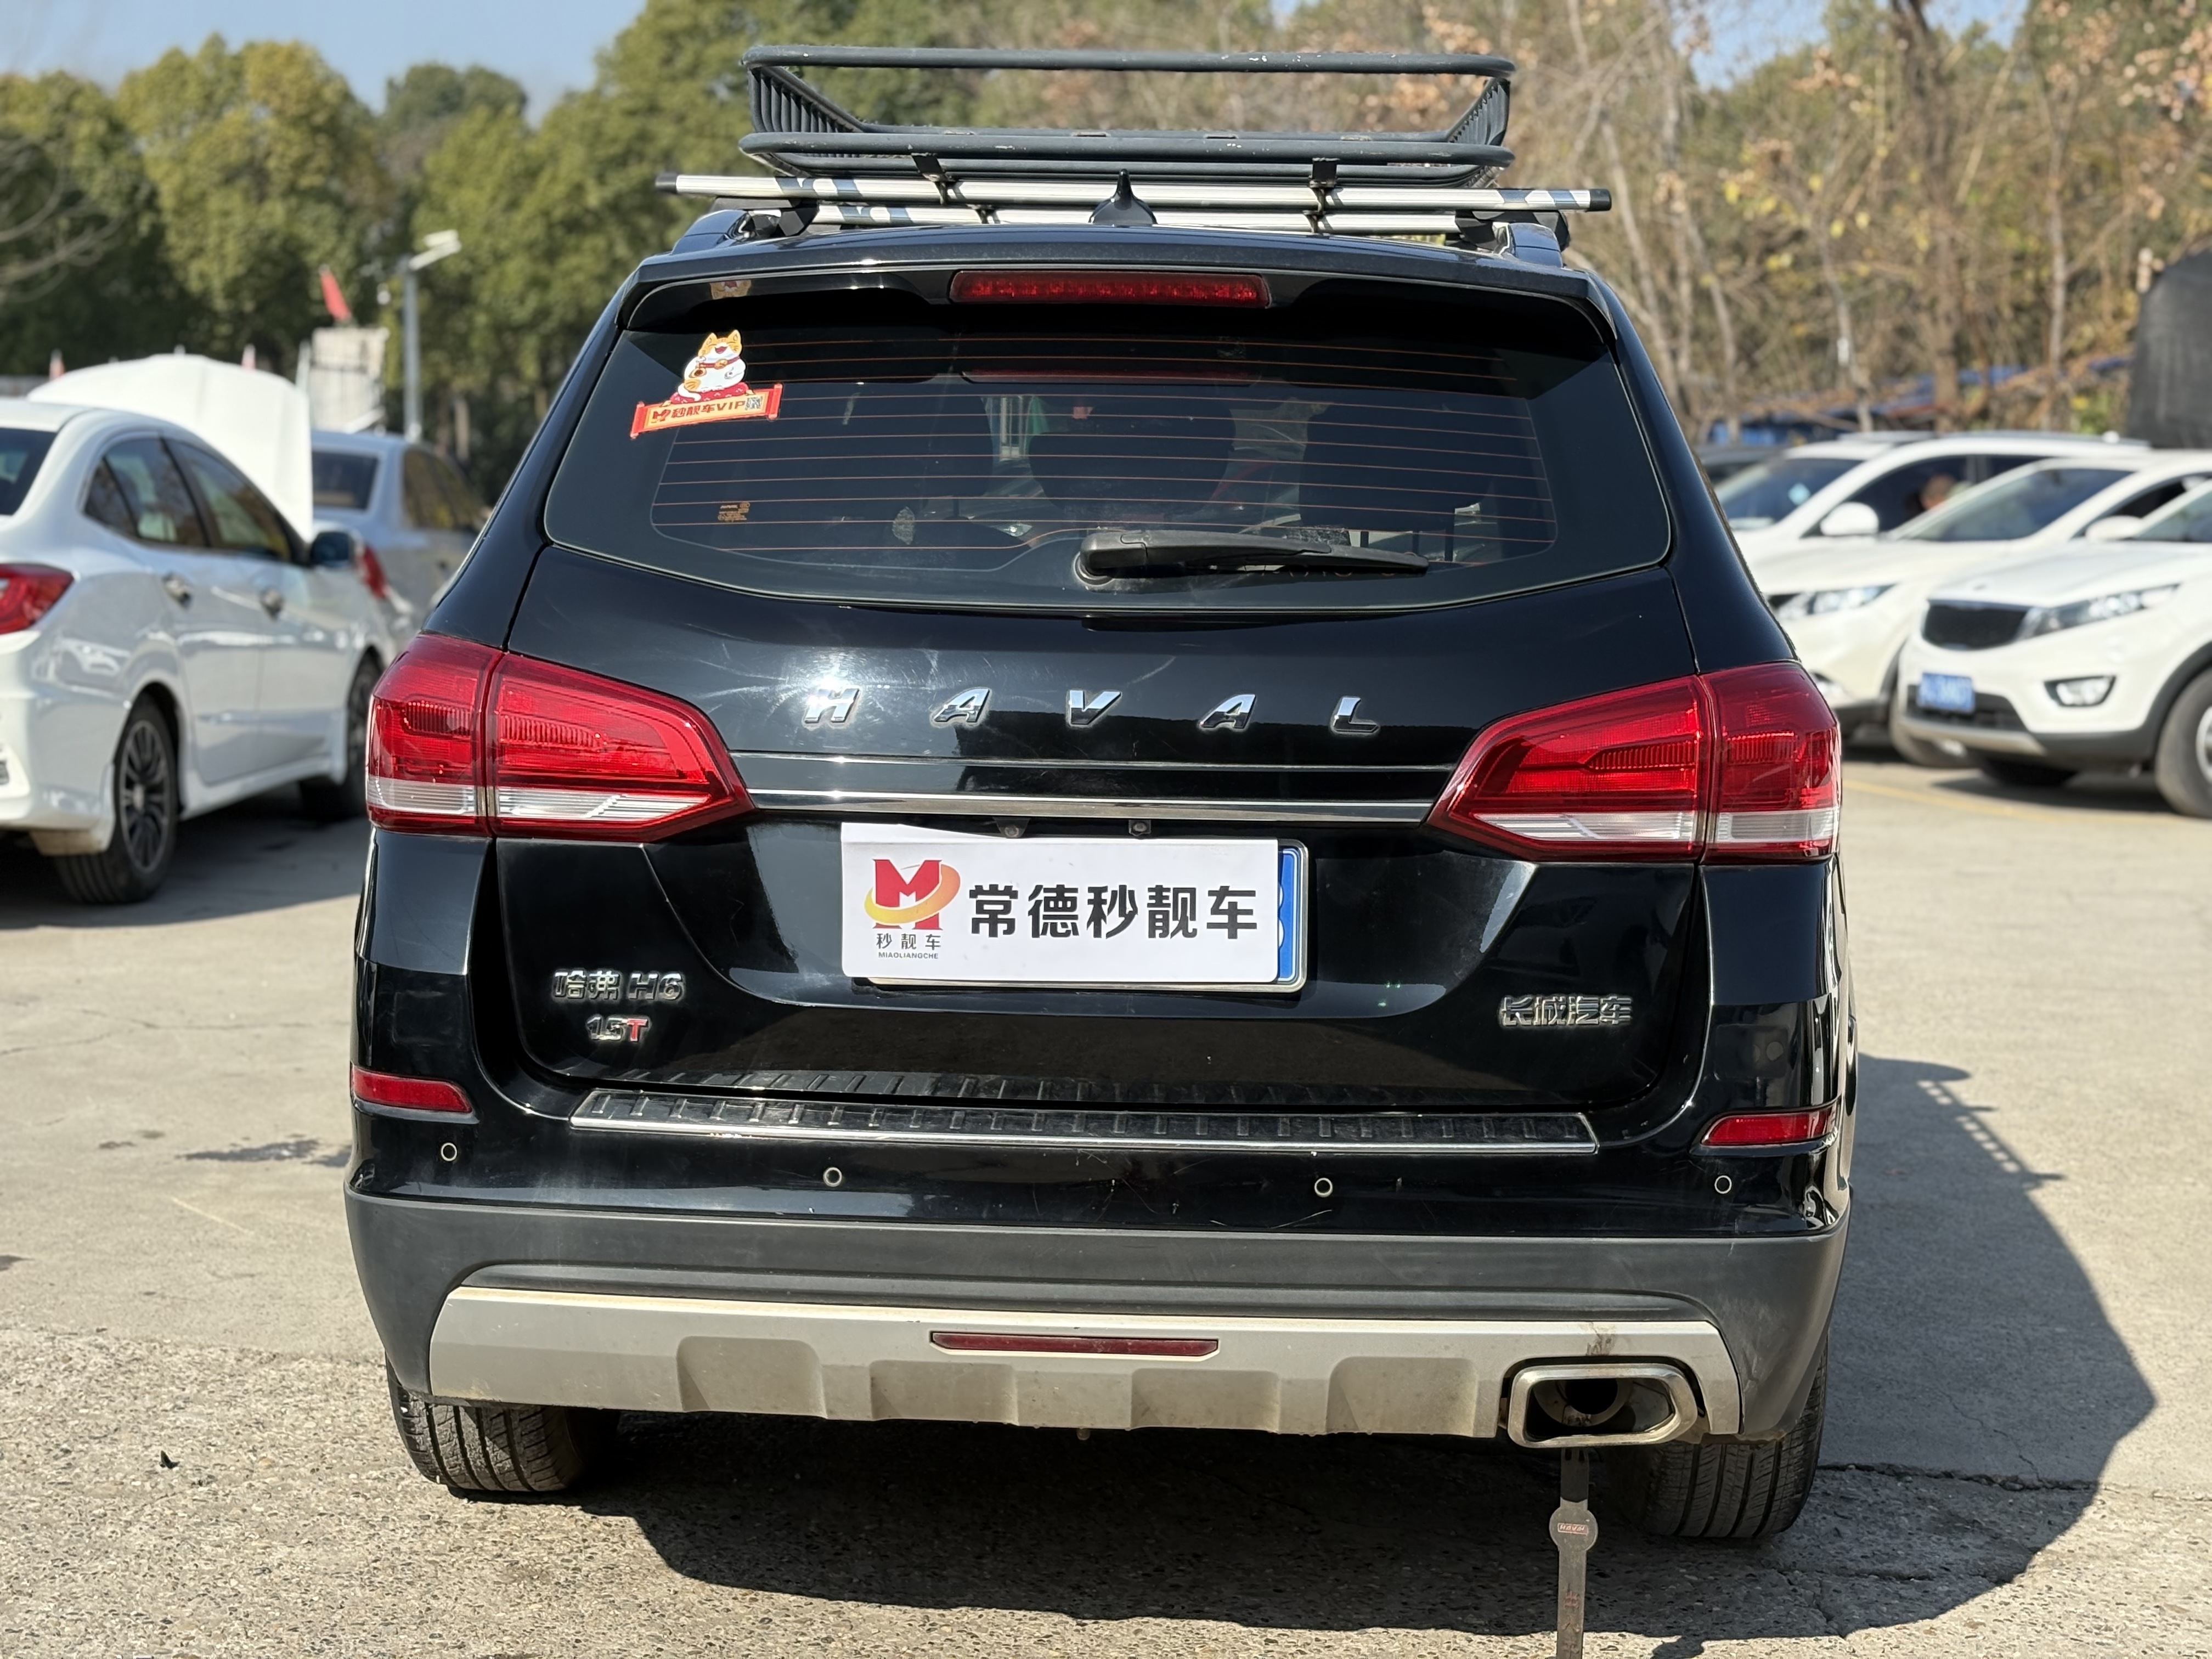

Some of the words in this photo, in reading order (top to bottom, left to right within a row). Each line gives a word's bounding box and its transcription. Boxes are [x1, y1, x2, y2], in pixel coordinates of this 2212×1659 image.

[804, 687, 1379, 733] HAVAL
[969, 884, 1257, 939] 常德秒靓车
[876, 933, 941, 950] 秒靓车
[554, 970, 620, 1000] 哈弗
[628, 973, 683, 1000] H6
[1501, 995, 1632, 1026] 长城汽车
